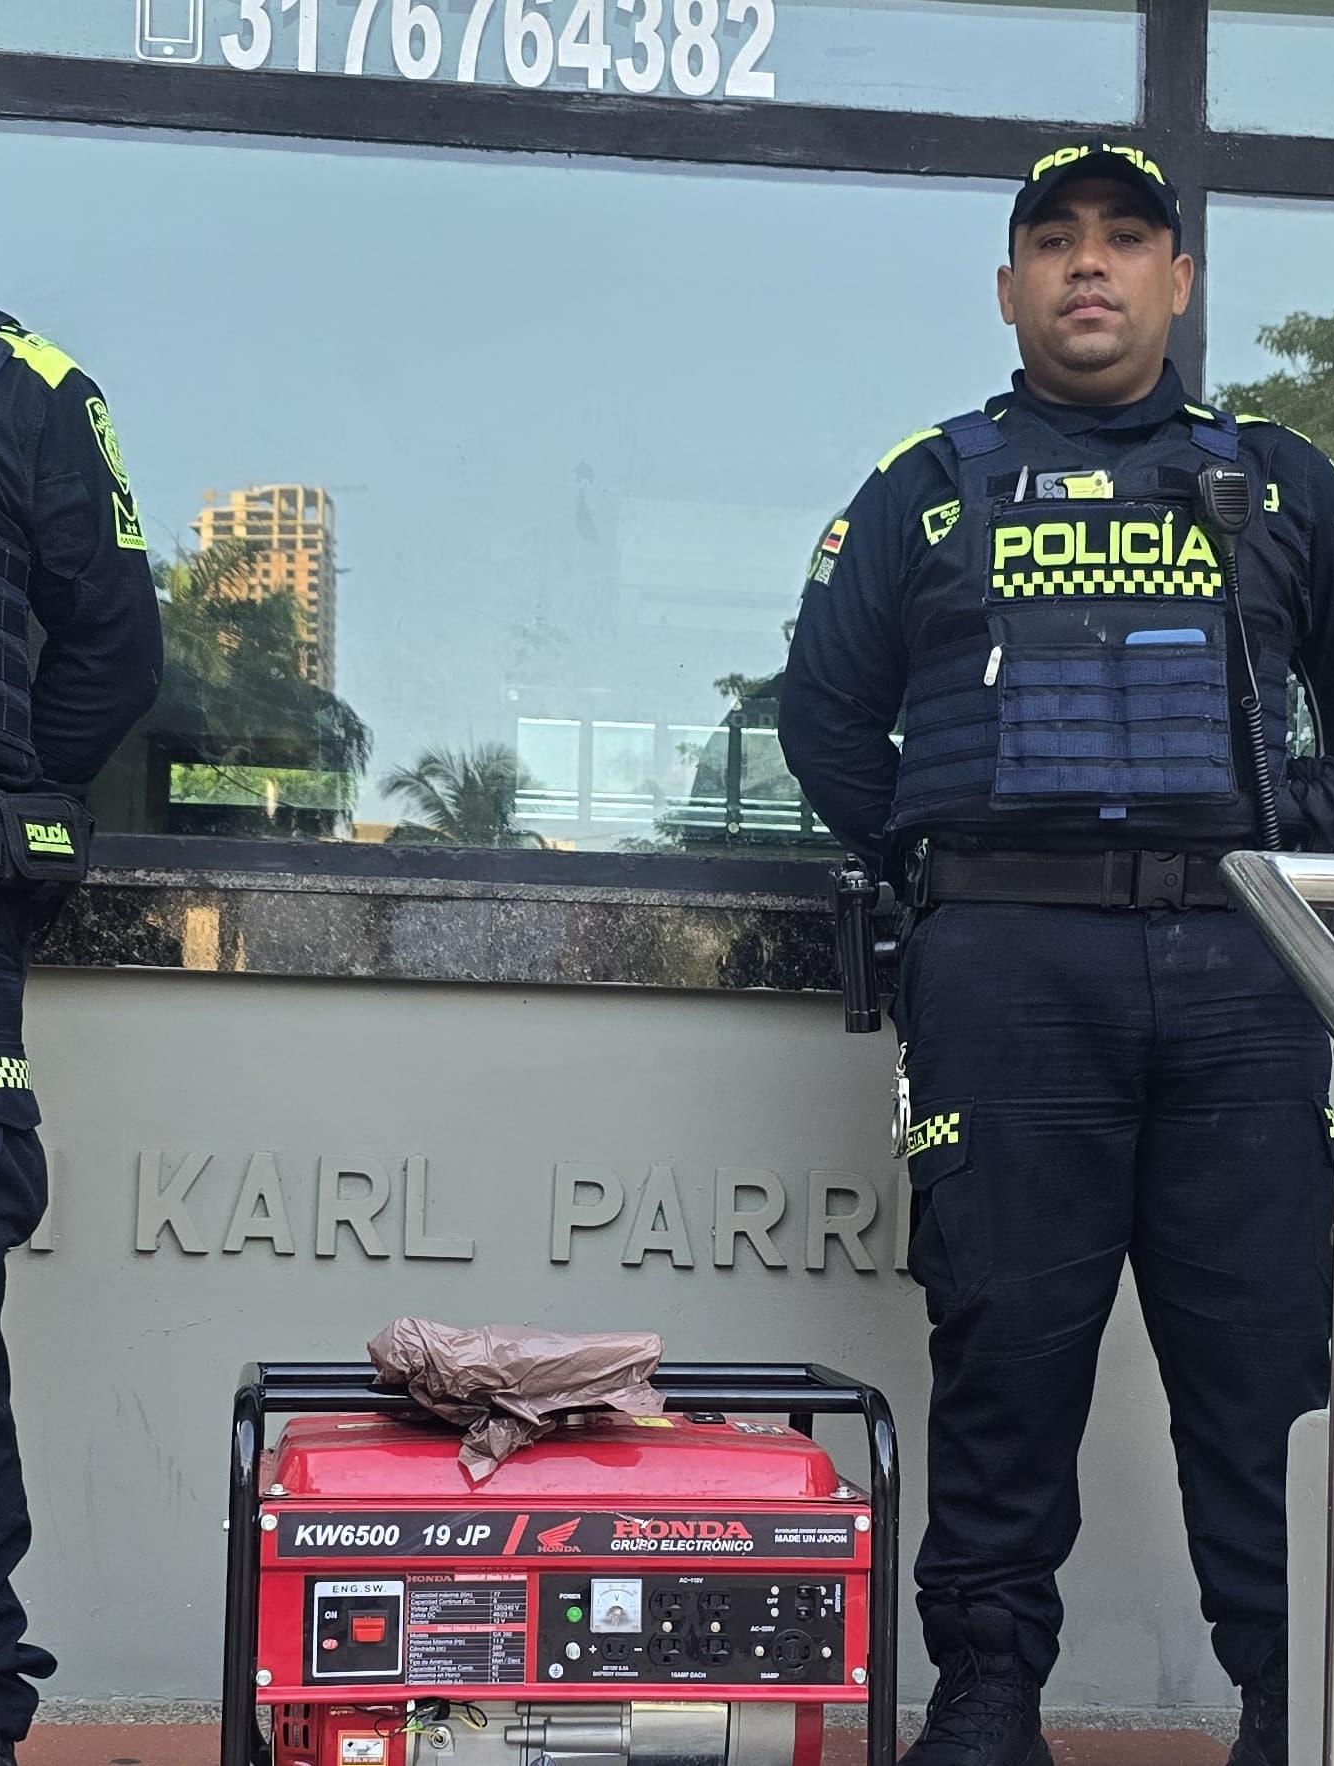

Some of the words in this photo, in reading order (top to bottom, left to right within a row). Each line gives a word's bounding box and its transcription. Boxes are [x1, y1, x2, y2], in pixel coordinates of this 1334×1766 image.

[220, 0, 776, 98] 3176764382
[993, 510, 1218, 570] POLICÍA
[134, 1148, 475, 1262] KARL
[294, 1524, 400, 1546] KW6500
[421, 1524, 452, 1546] 19
[456, 1524, 491, 1546] JP
[613, 1519, 753, 1539] HONDA
[537, 1545, 582, 1553] HONDA
[610, 1539, 658, 1552] GRUPO
[659, 1537, 754, 1552] ELECTRÓNICO
[324, 1610, 338, 1619] ON
